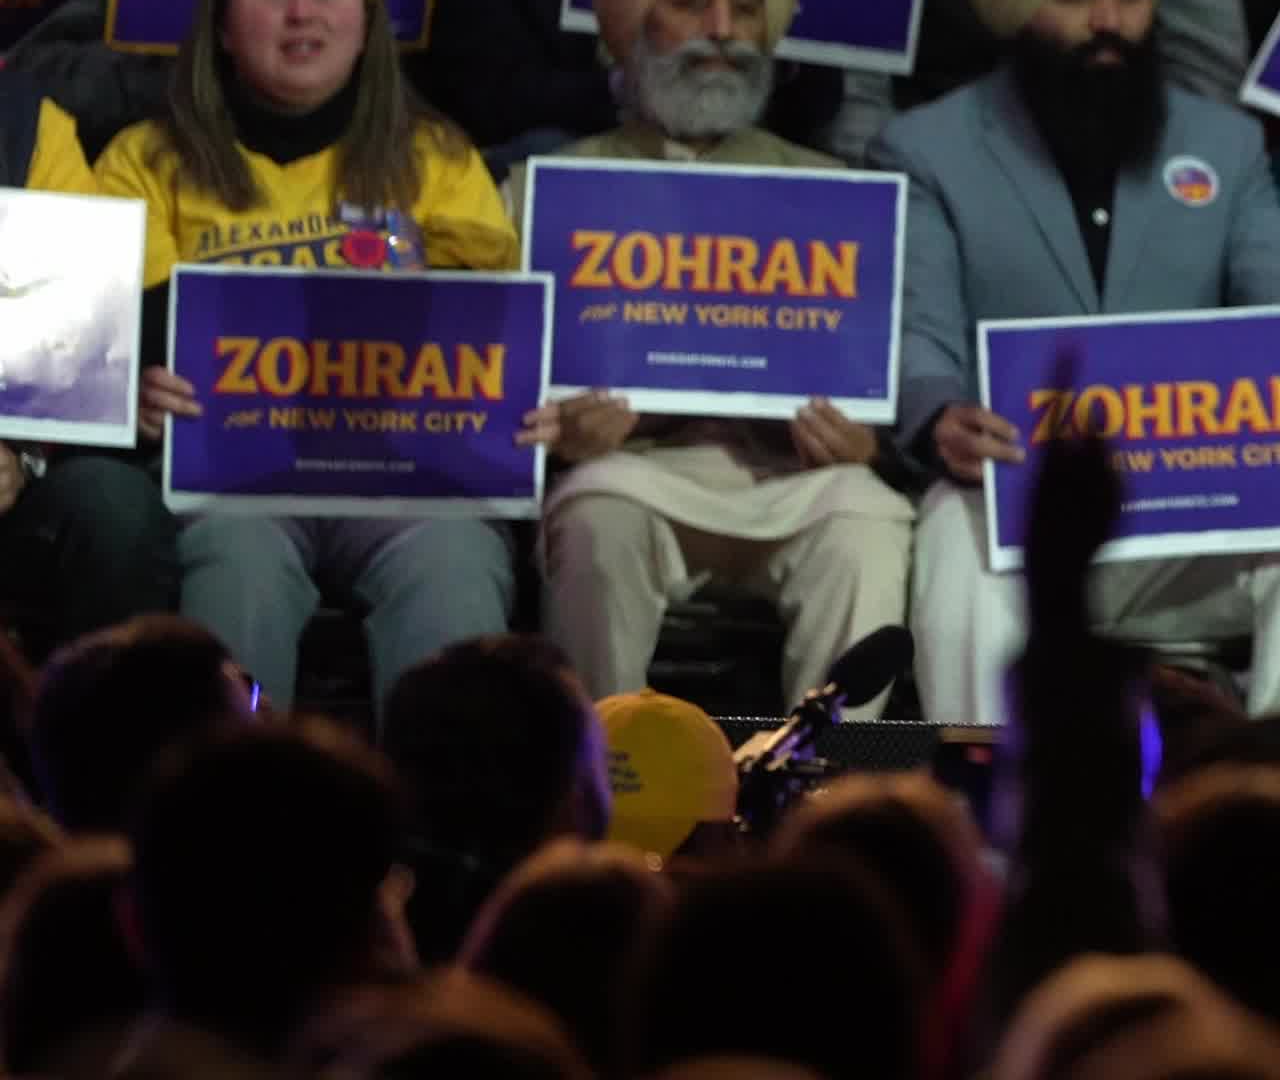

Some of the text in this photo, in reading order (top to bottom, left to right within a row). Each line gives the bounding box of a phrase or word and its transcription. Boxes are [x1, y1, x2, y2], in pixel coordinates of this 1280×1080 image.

[569, 228, 860, 299] ZOHRAN
[622, 301, 689, 324] NEW
[694, 302, 769, 330] YORK
[776, 305, 844, 332] CITY
[212, 336, 506, 400] ZOHRAN
[268, 406, 336, 430] NEW
[344, 407, 418, 432] YORK
[425, 409, 488, 434] CITY
[1161, 443, 1237, 471] YORK
